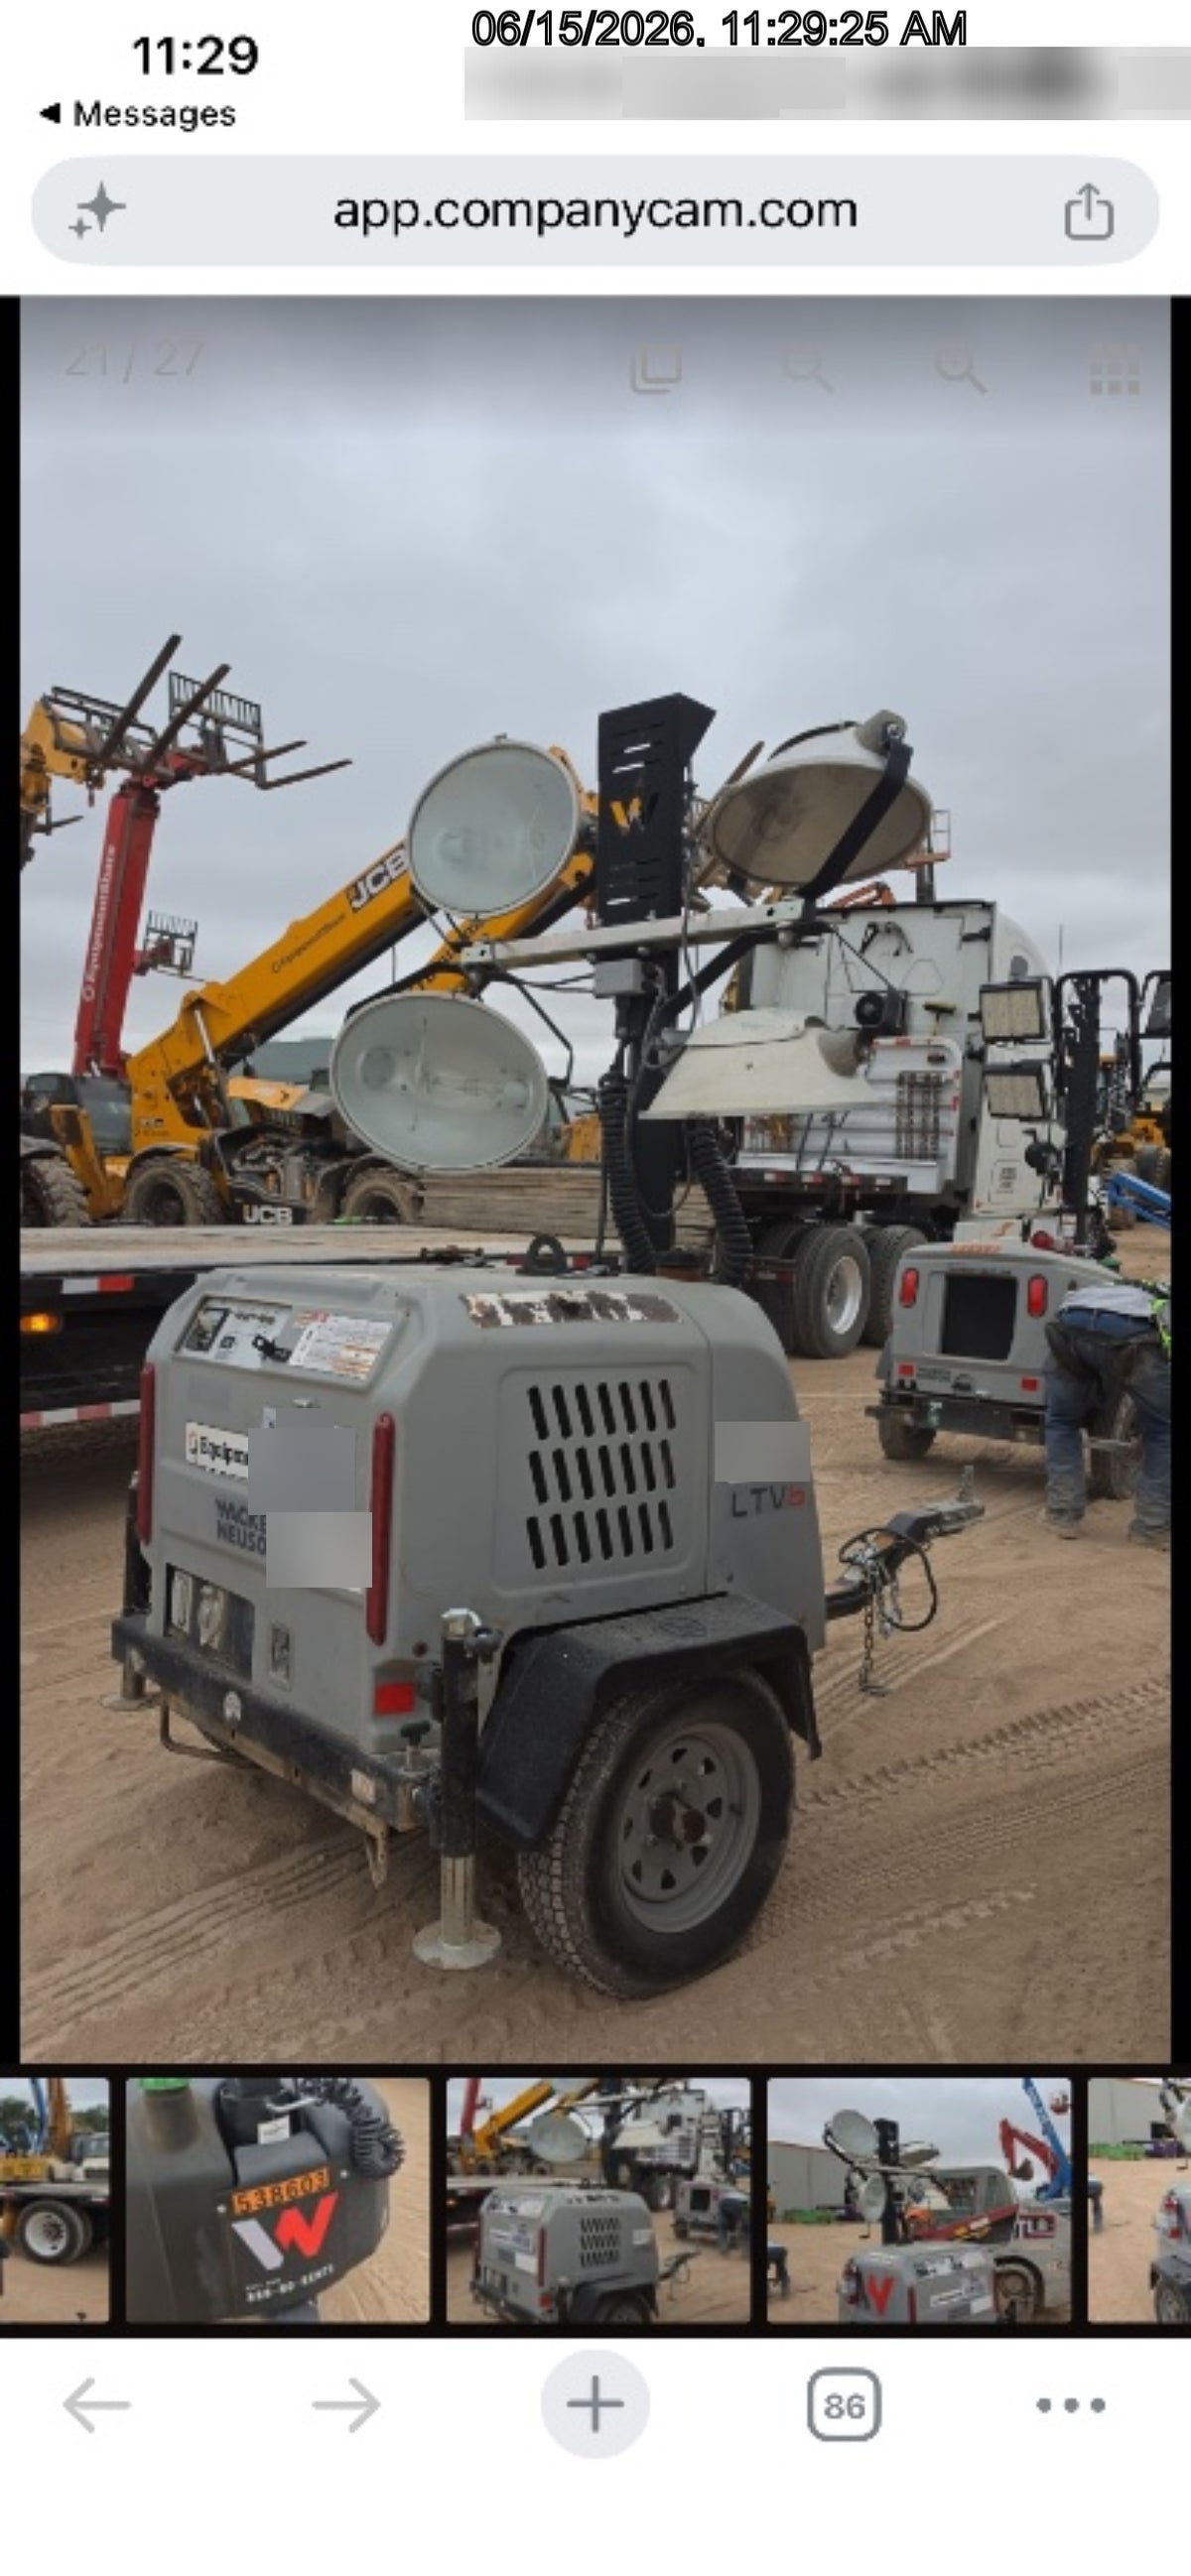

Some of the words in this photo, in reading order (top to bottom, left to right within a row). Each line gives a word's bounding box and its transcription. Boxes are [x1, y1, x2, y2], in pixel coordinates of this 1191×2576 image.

[133, 35, 259, 75] 11:29
[73, 100, 237, 132] Messages
[333, 197, 859, 238] app.companycam.com
[64, 340, 108, 377] 21
[154, 337, 206, 377] 27
[348, 845, 408, 911] JCB
[242, 1203, 294, 1224] JCB
[216, 1518, 266, 1556] NEUSO
[234, 2169, 329, 2214] 538603
[824, 2391, 866, 2419] 86
